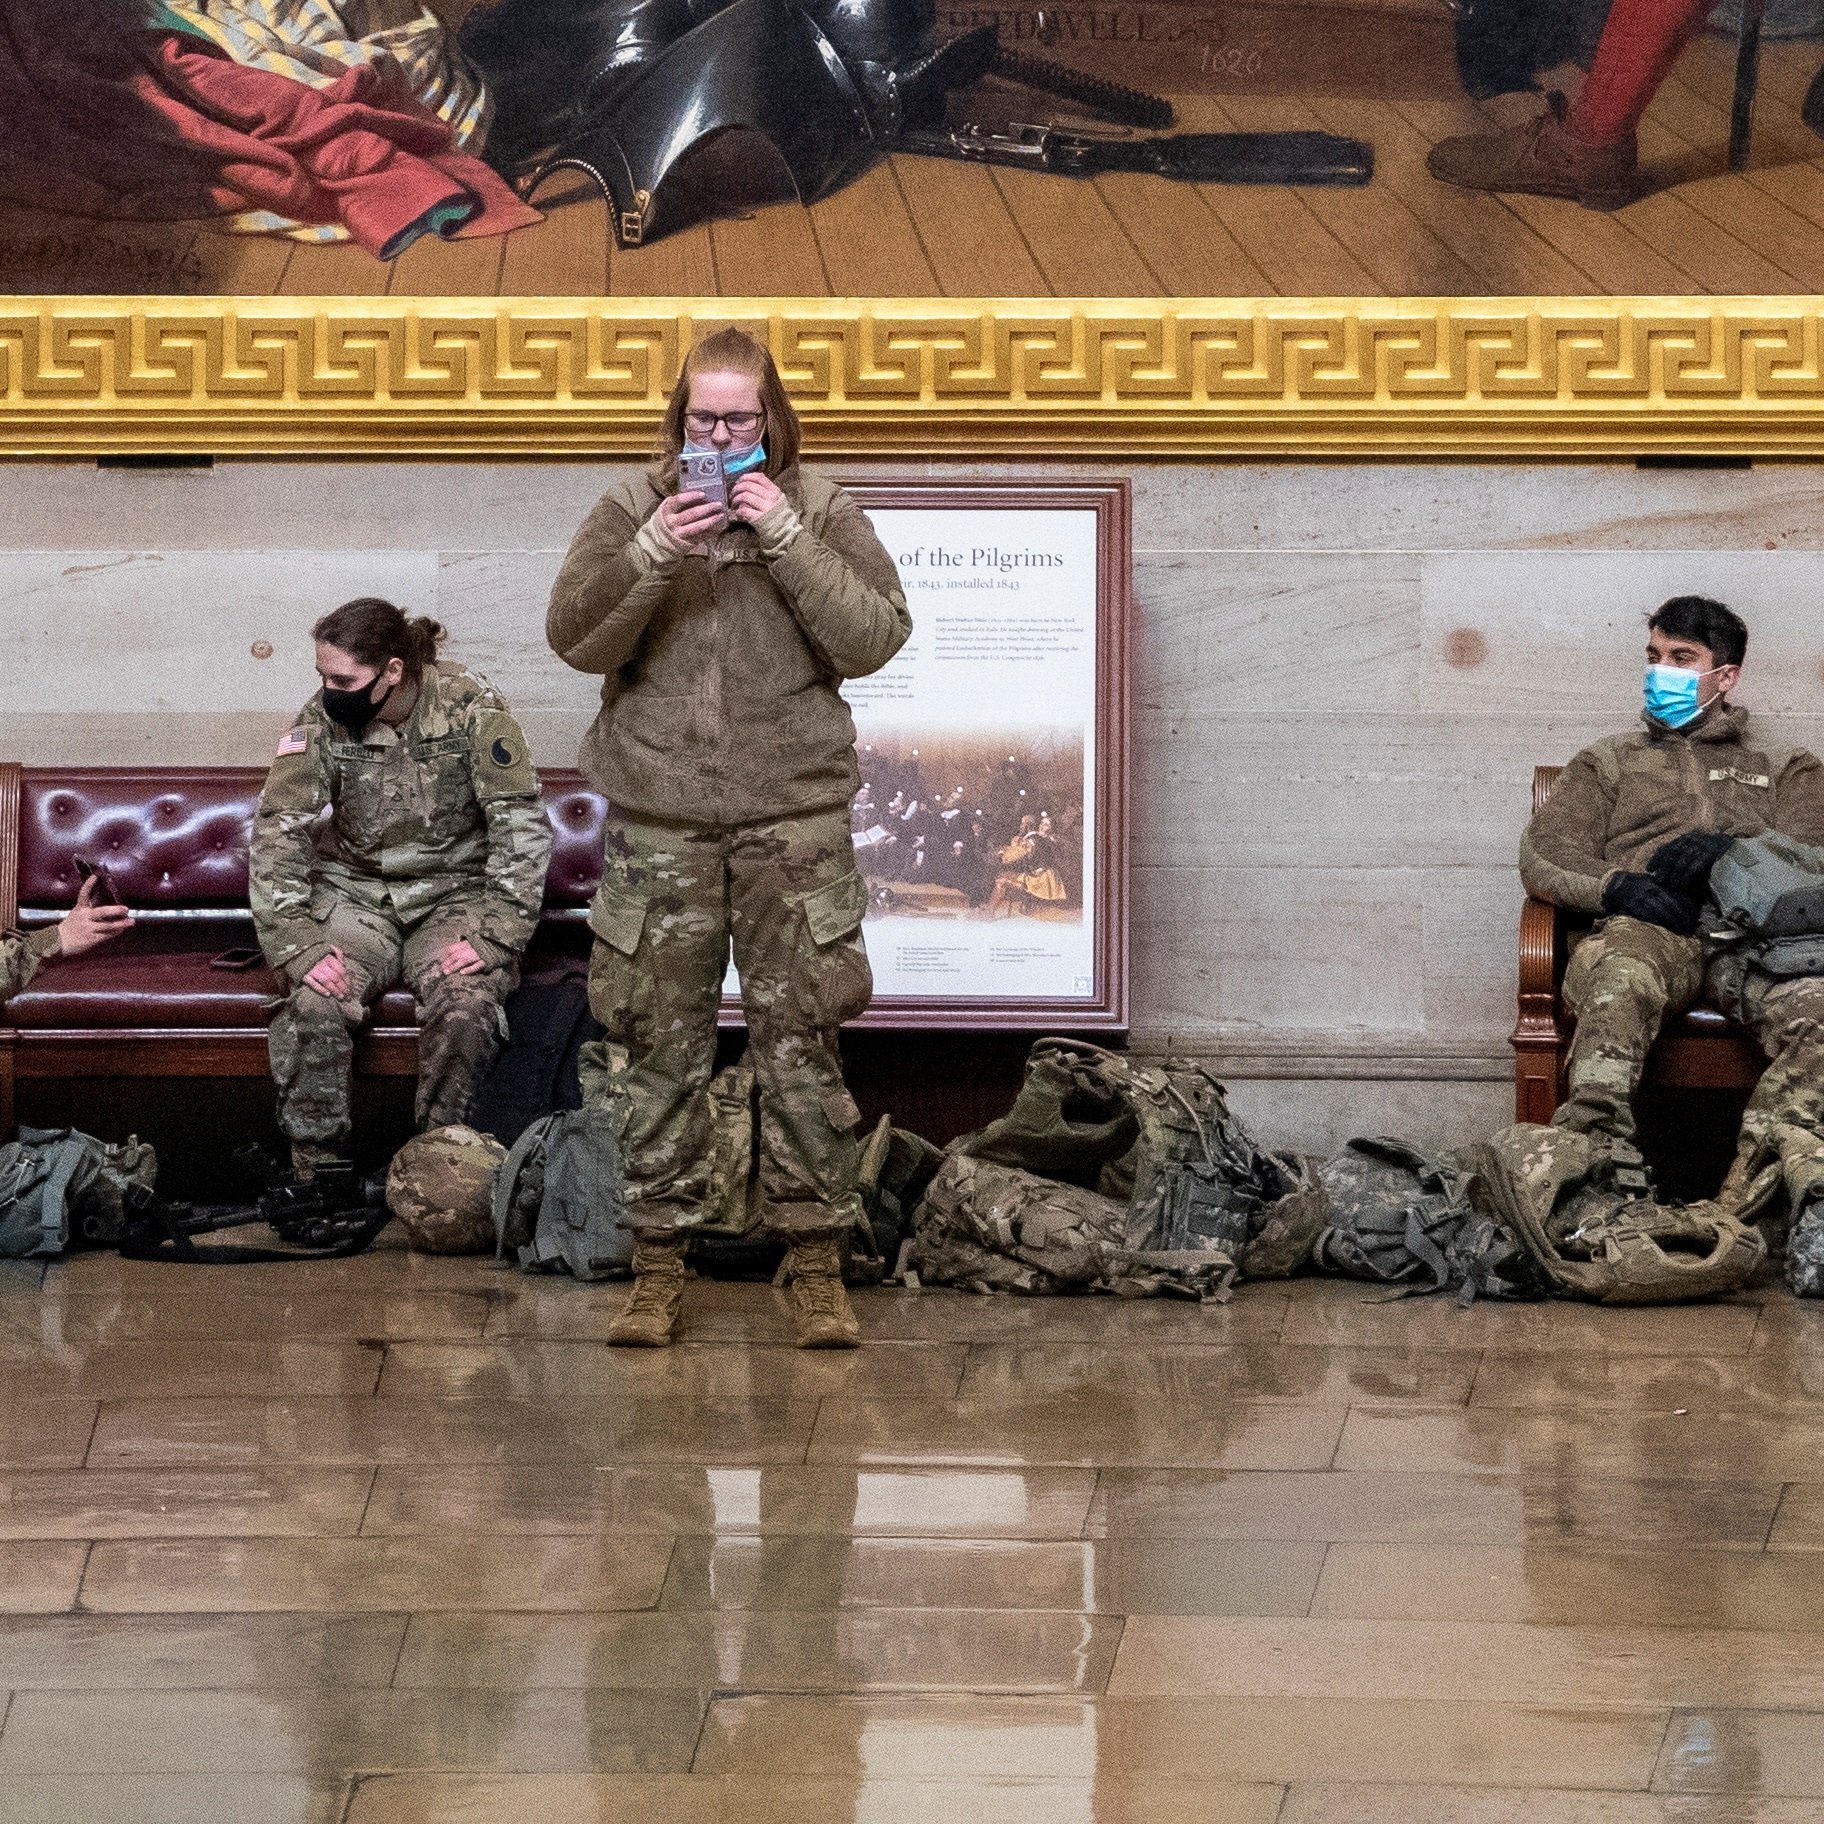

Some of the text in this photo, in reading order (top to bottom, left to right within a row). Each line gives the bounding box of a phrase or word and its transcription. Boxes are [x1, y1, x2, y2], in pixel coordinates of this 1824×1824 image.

[899, 547, 1063, 572] of the Pilgrims
[947, 578, 993, 588] installed
[997, 579, 1020, 591] 1843
